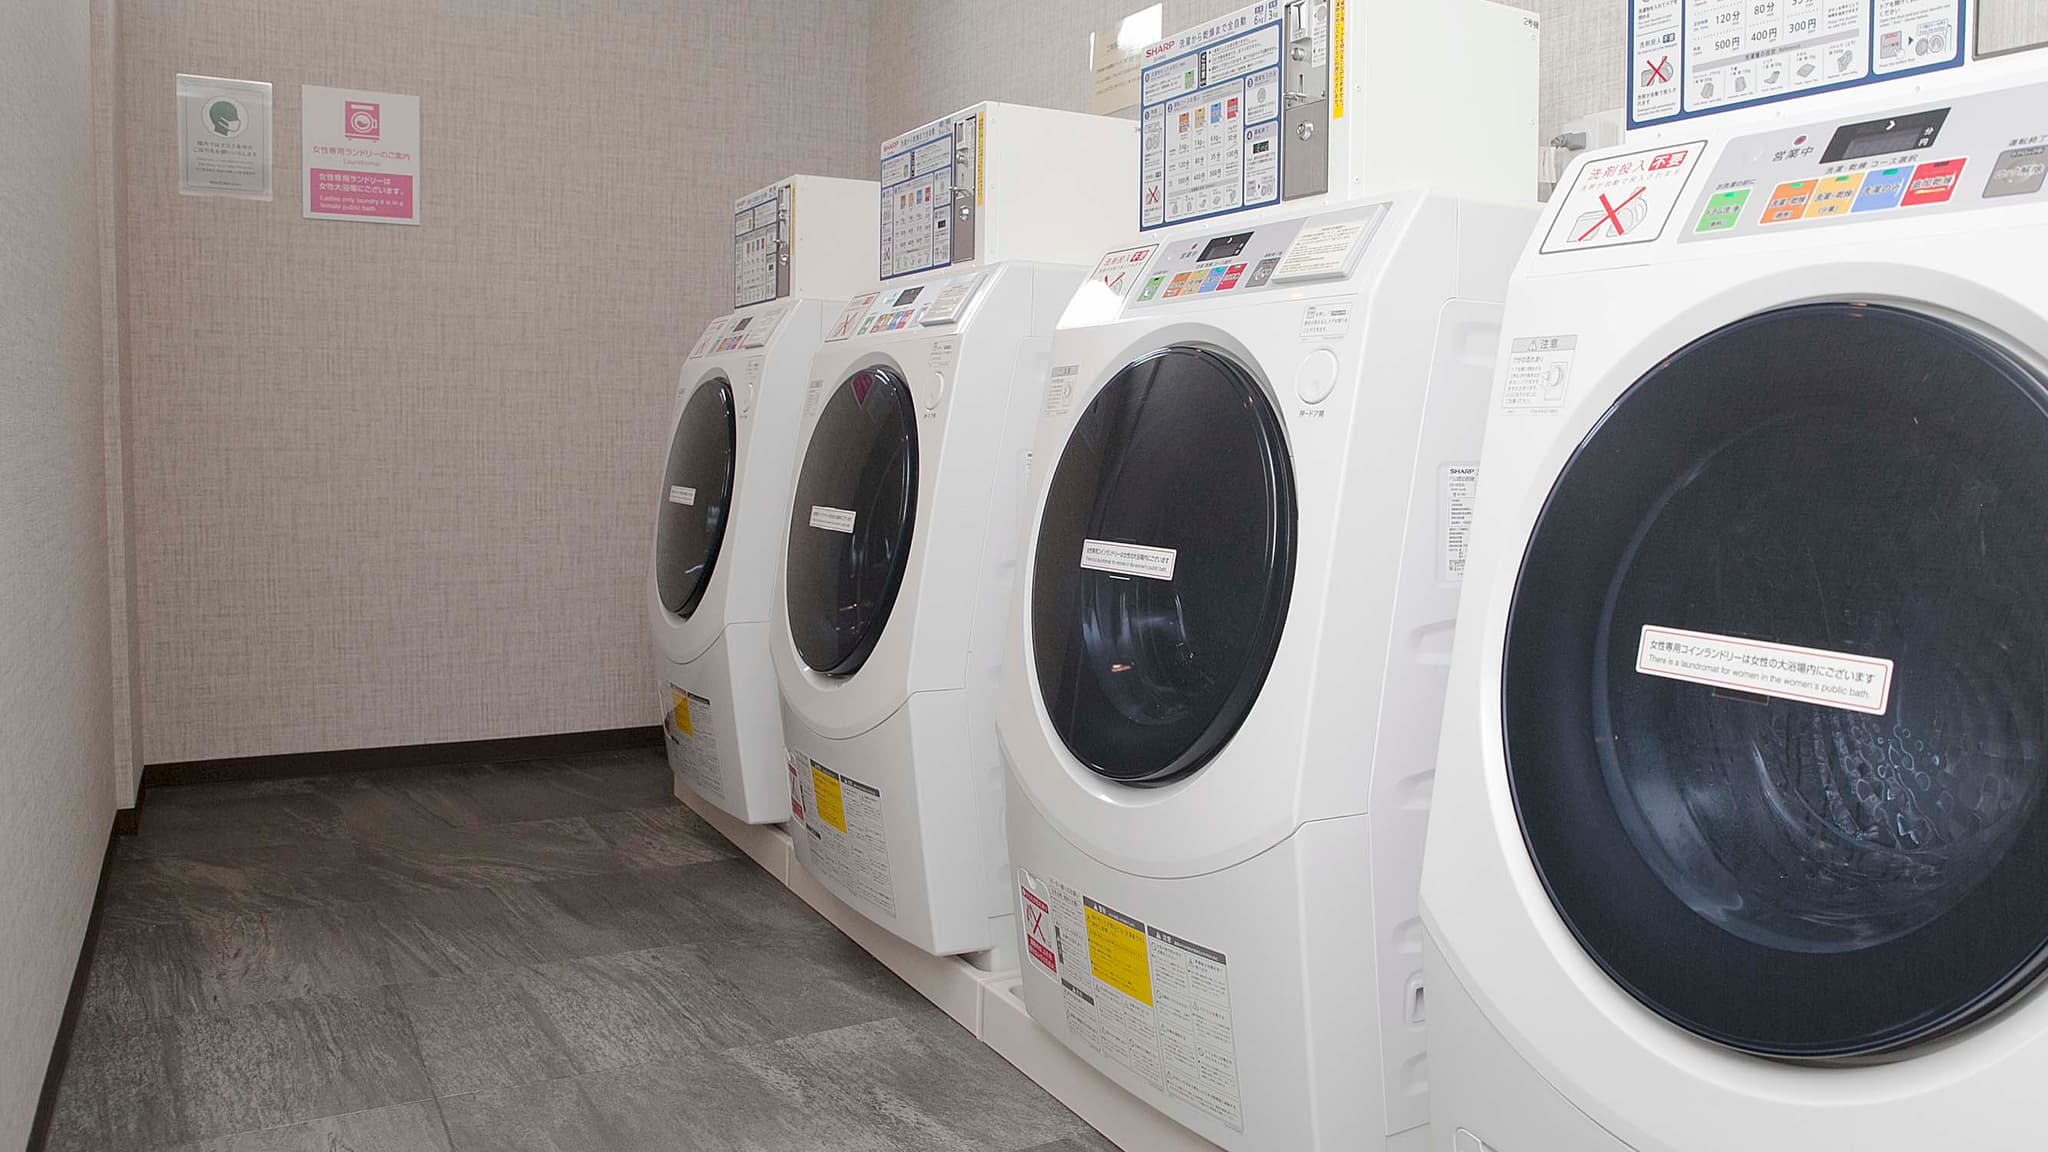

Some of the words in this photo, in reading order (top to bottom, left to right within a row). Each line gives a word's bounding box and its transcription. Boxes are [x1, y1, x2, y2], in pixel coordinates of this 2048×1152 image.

[1754, 2, 1775, 15] 80分
[1716, 11, 1741, 24] 120分
[1788, 18, 1816, 34] 300円
[1751, 28, 1778, 42] 400円
[1145, 40, 1175, 58] SHARP
[1714, 37, 1740, 51] 500円
[1772, 147, 1814, 162] 営業中
[320, 173, 391, 184] 女性専用ランドリーは
[1650, 640, 1876, 684] 女性専用コインランドリーは女性の大浴場内にございます
[1649, 654, 1666, 664] There
[1681, 659, 1720, 672] laundromat
[1721, 666, 1730, 674] for
[1732, 670, 1759, 680] women
[1770, 674, 1782, 683] the
[1784, 678, 1819, 690] women's
[1821, 684, 1847, 694] public
